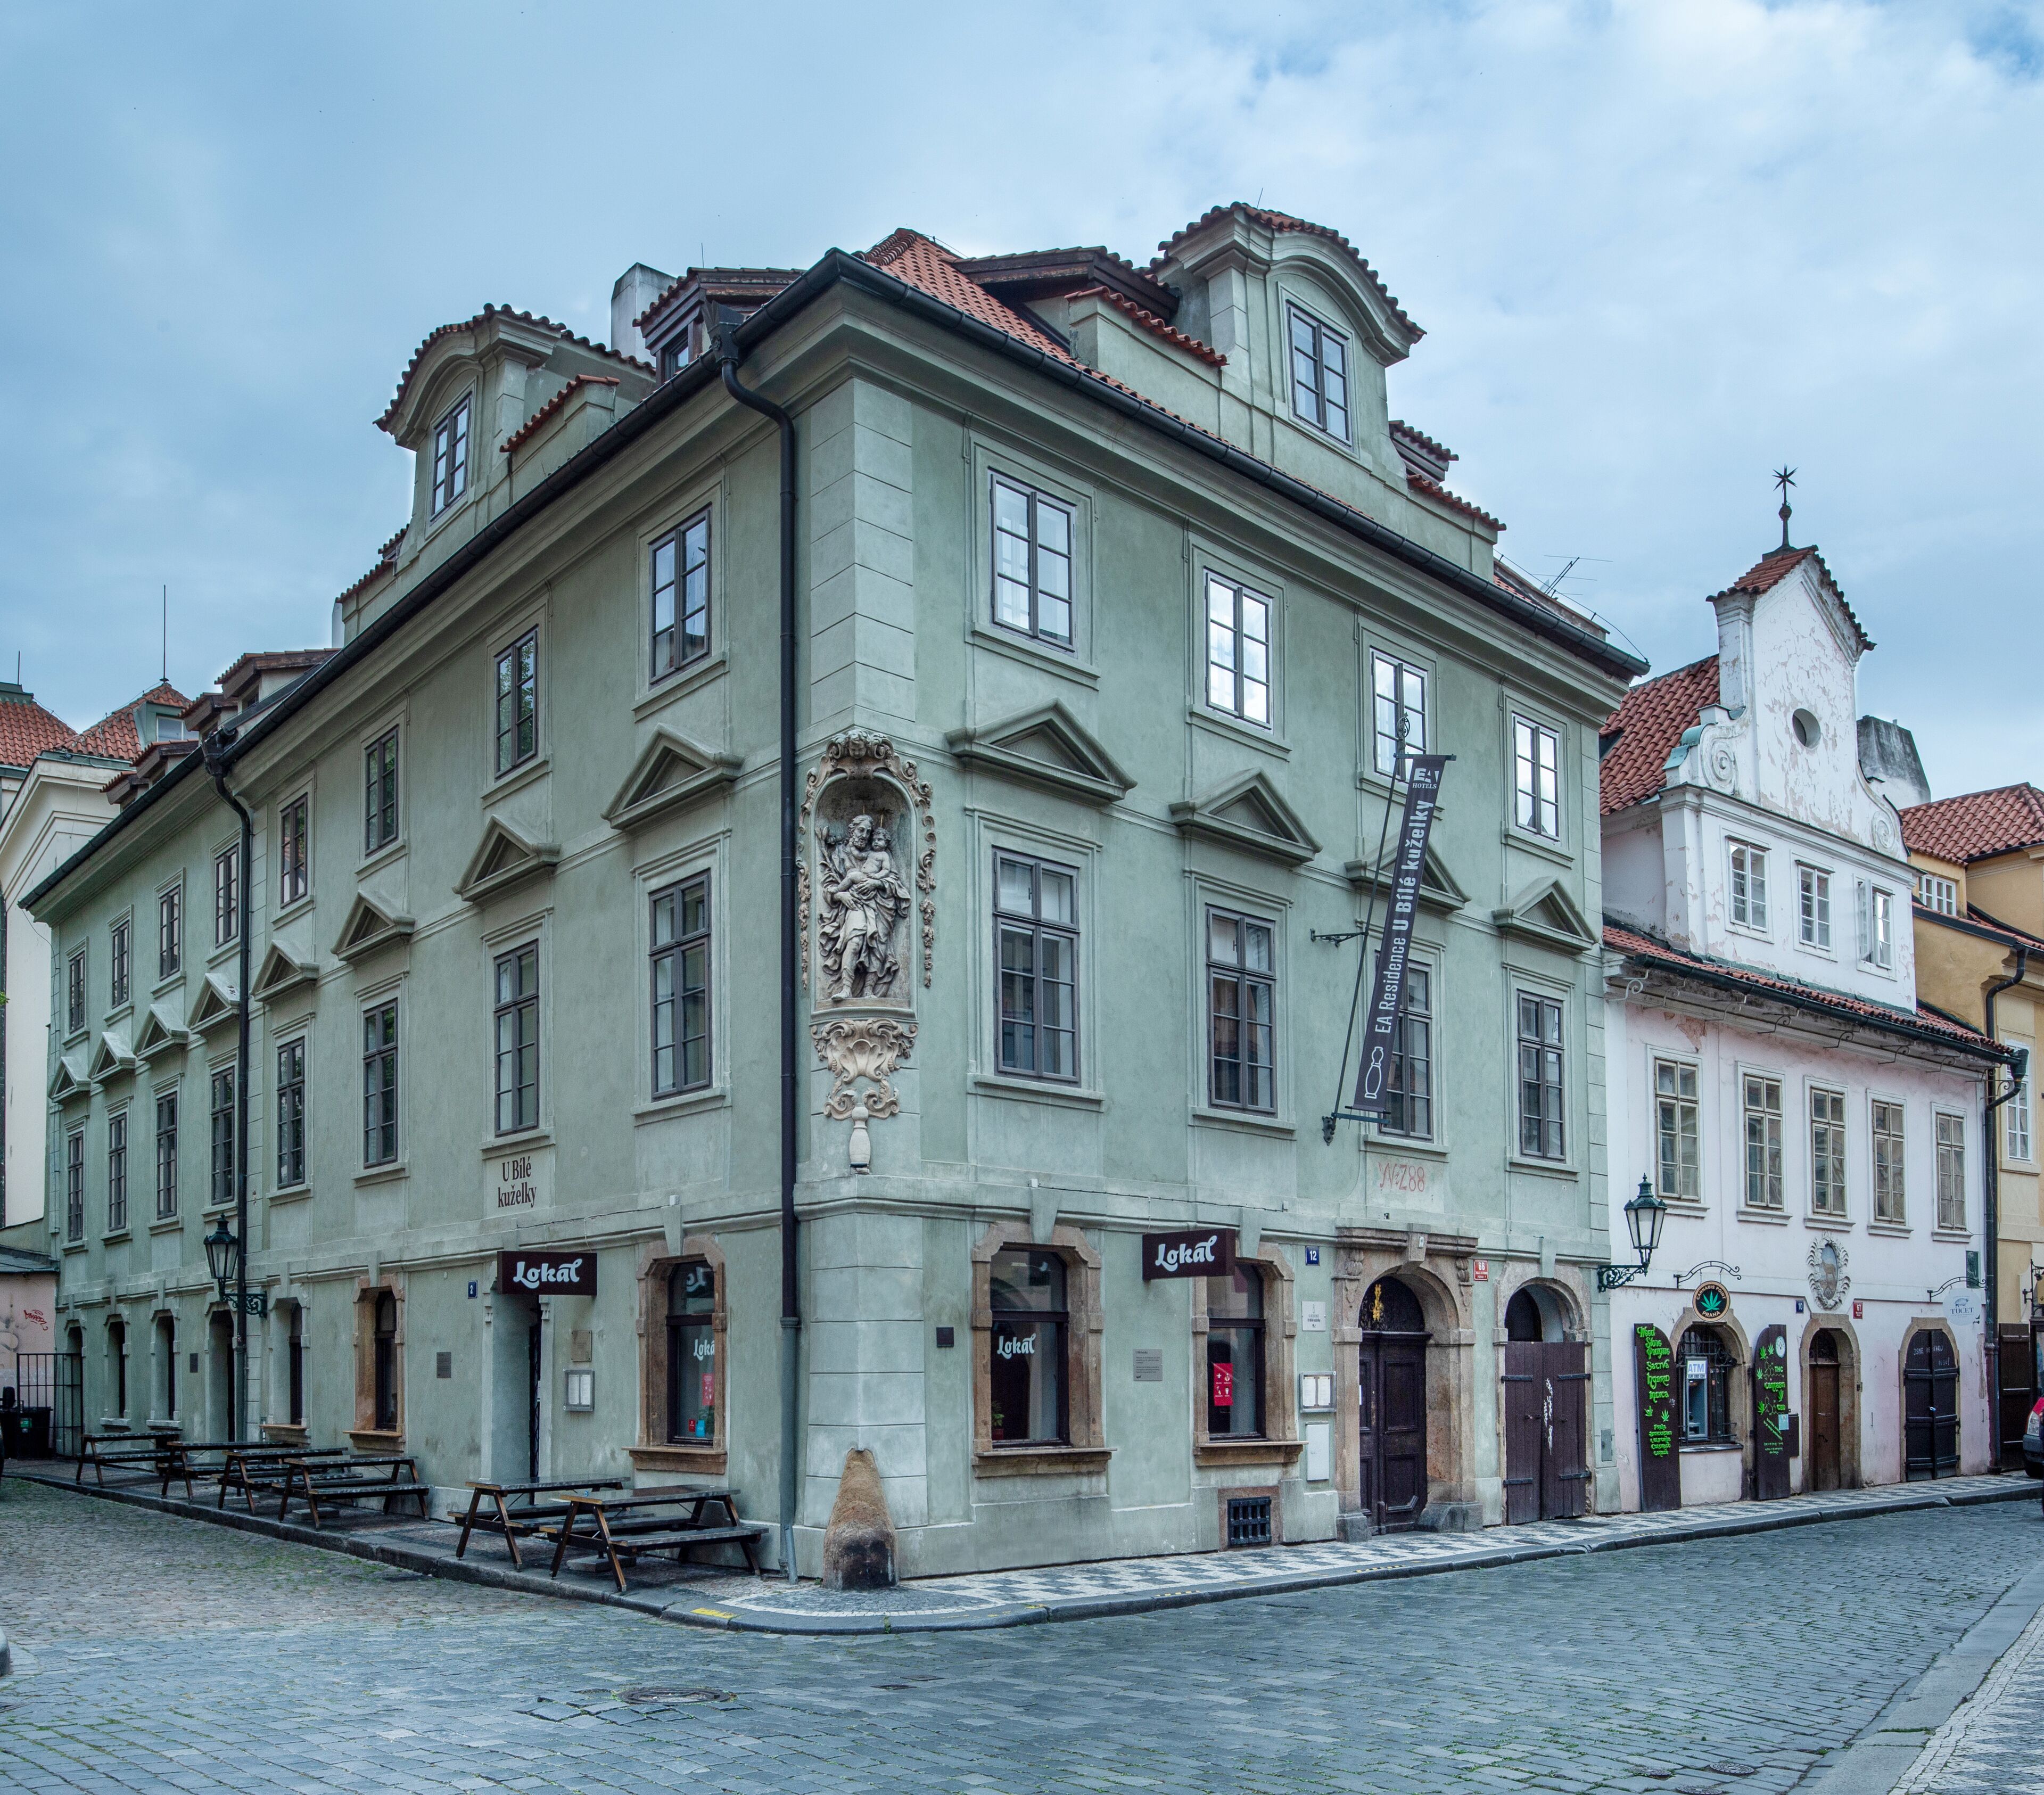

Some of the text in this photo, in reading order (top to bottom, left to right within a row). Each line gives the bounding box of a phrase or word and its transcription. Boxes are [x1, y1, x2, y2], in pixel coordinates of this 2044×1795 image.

[1413, 768, 1440, 783] EA
[1375, 800, 1434, 1033] EA Residence U Bílé kuželky
[502, 1156, 532, 1182] U Bílé
[498, 1181, 537, 1208] kuželky
[1309, 1250, 1317, 1261] 12
[1478, 1262, 1485, 1271] 66
[469, 1285, 473, 1294] 2
[1696, 1285, 1726, 1300] CANNABIS POINT
[1636, 1326, 1655, 1337] Weed
[1688, 1363, 1704, 1373] ATM
